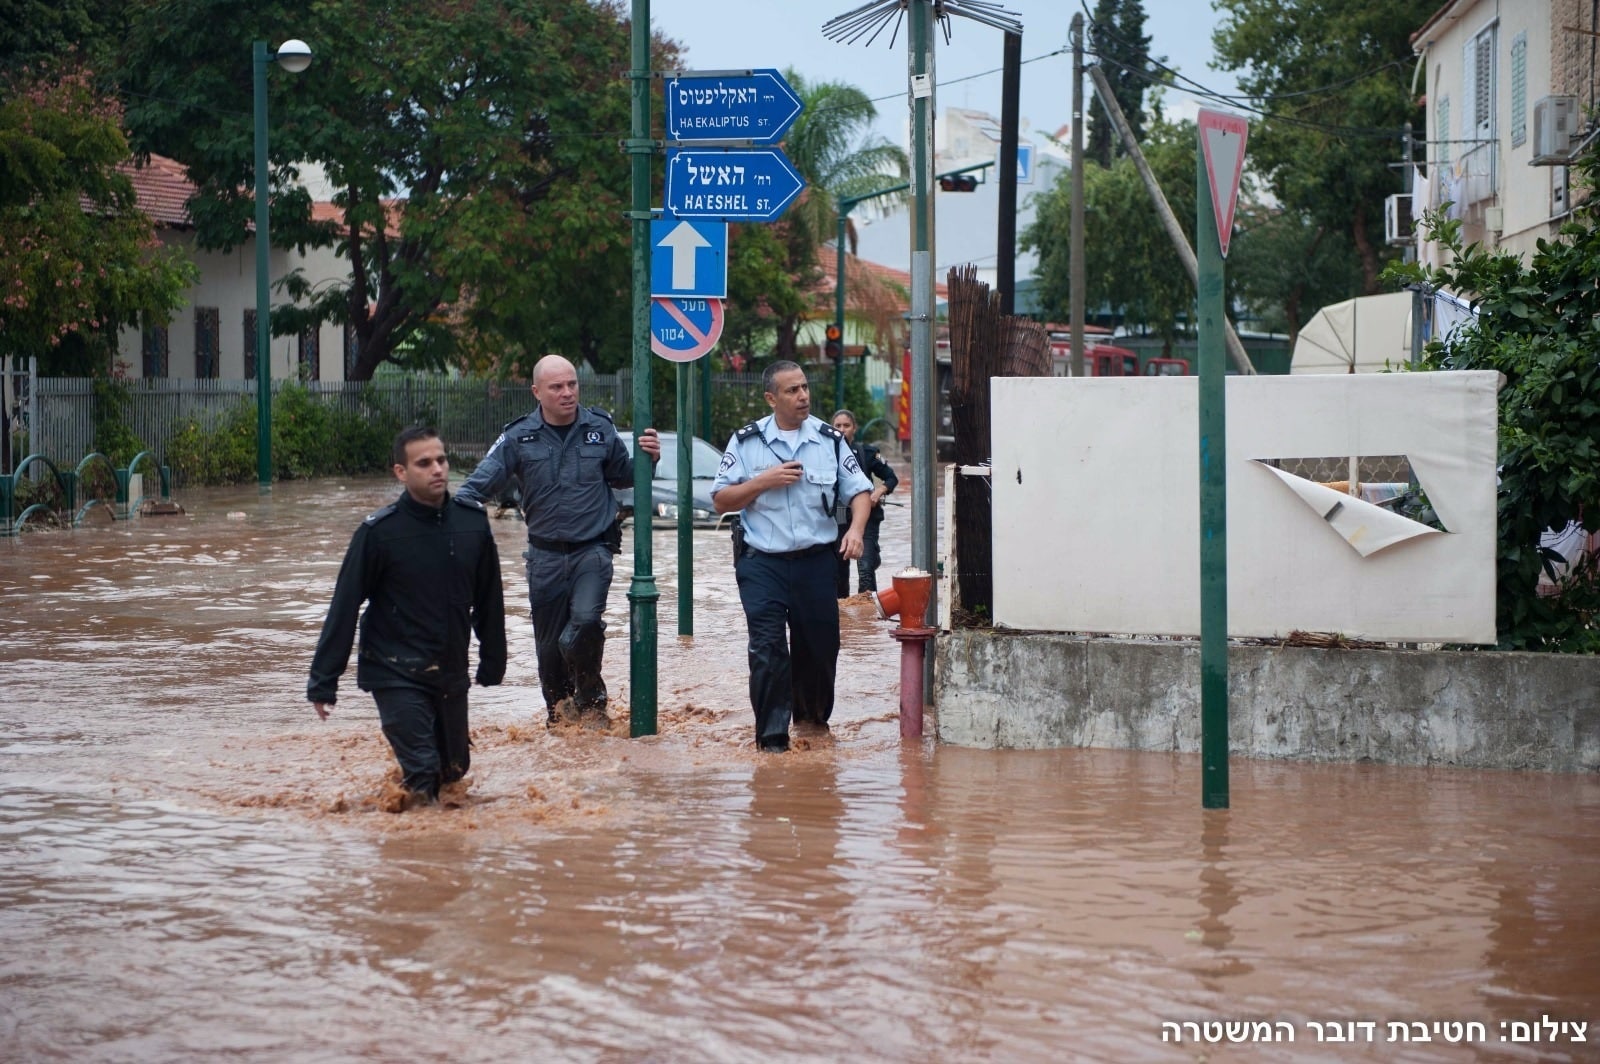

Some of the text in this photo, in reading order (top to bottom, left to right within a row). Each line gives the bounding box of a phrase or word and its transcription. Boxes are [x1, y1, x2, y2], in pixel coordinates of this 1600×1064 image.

[680, 82, 757, 109] האקליפטוס
[687, 157, 771, 186] רח' האשל
[756, 198, 771, 210] ST.
[681, 300, 706, 312] מעל
